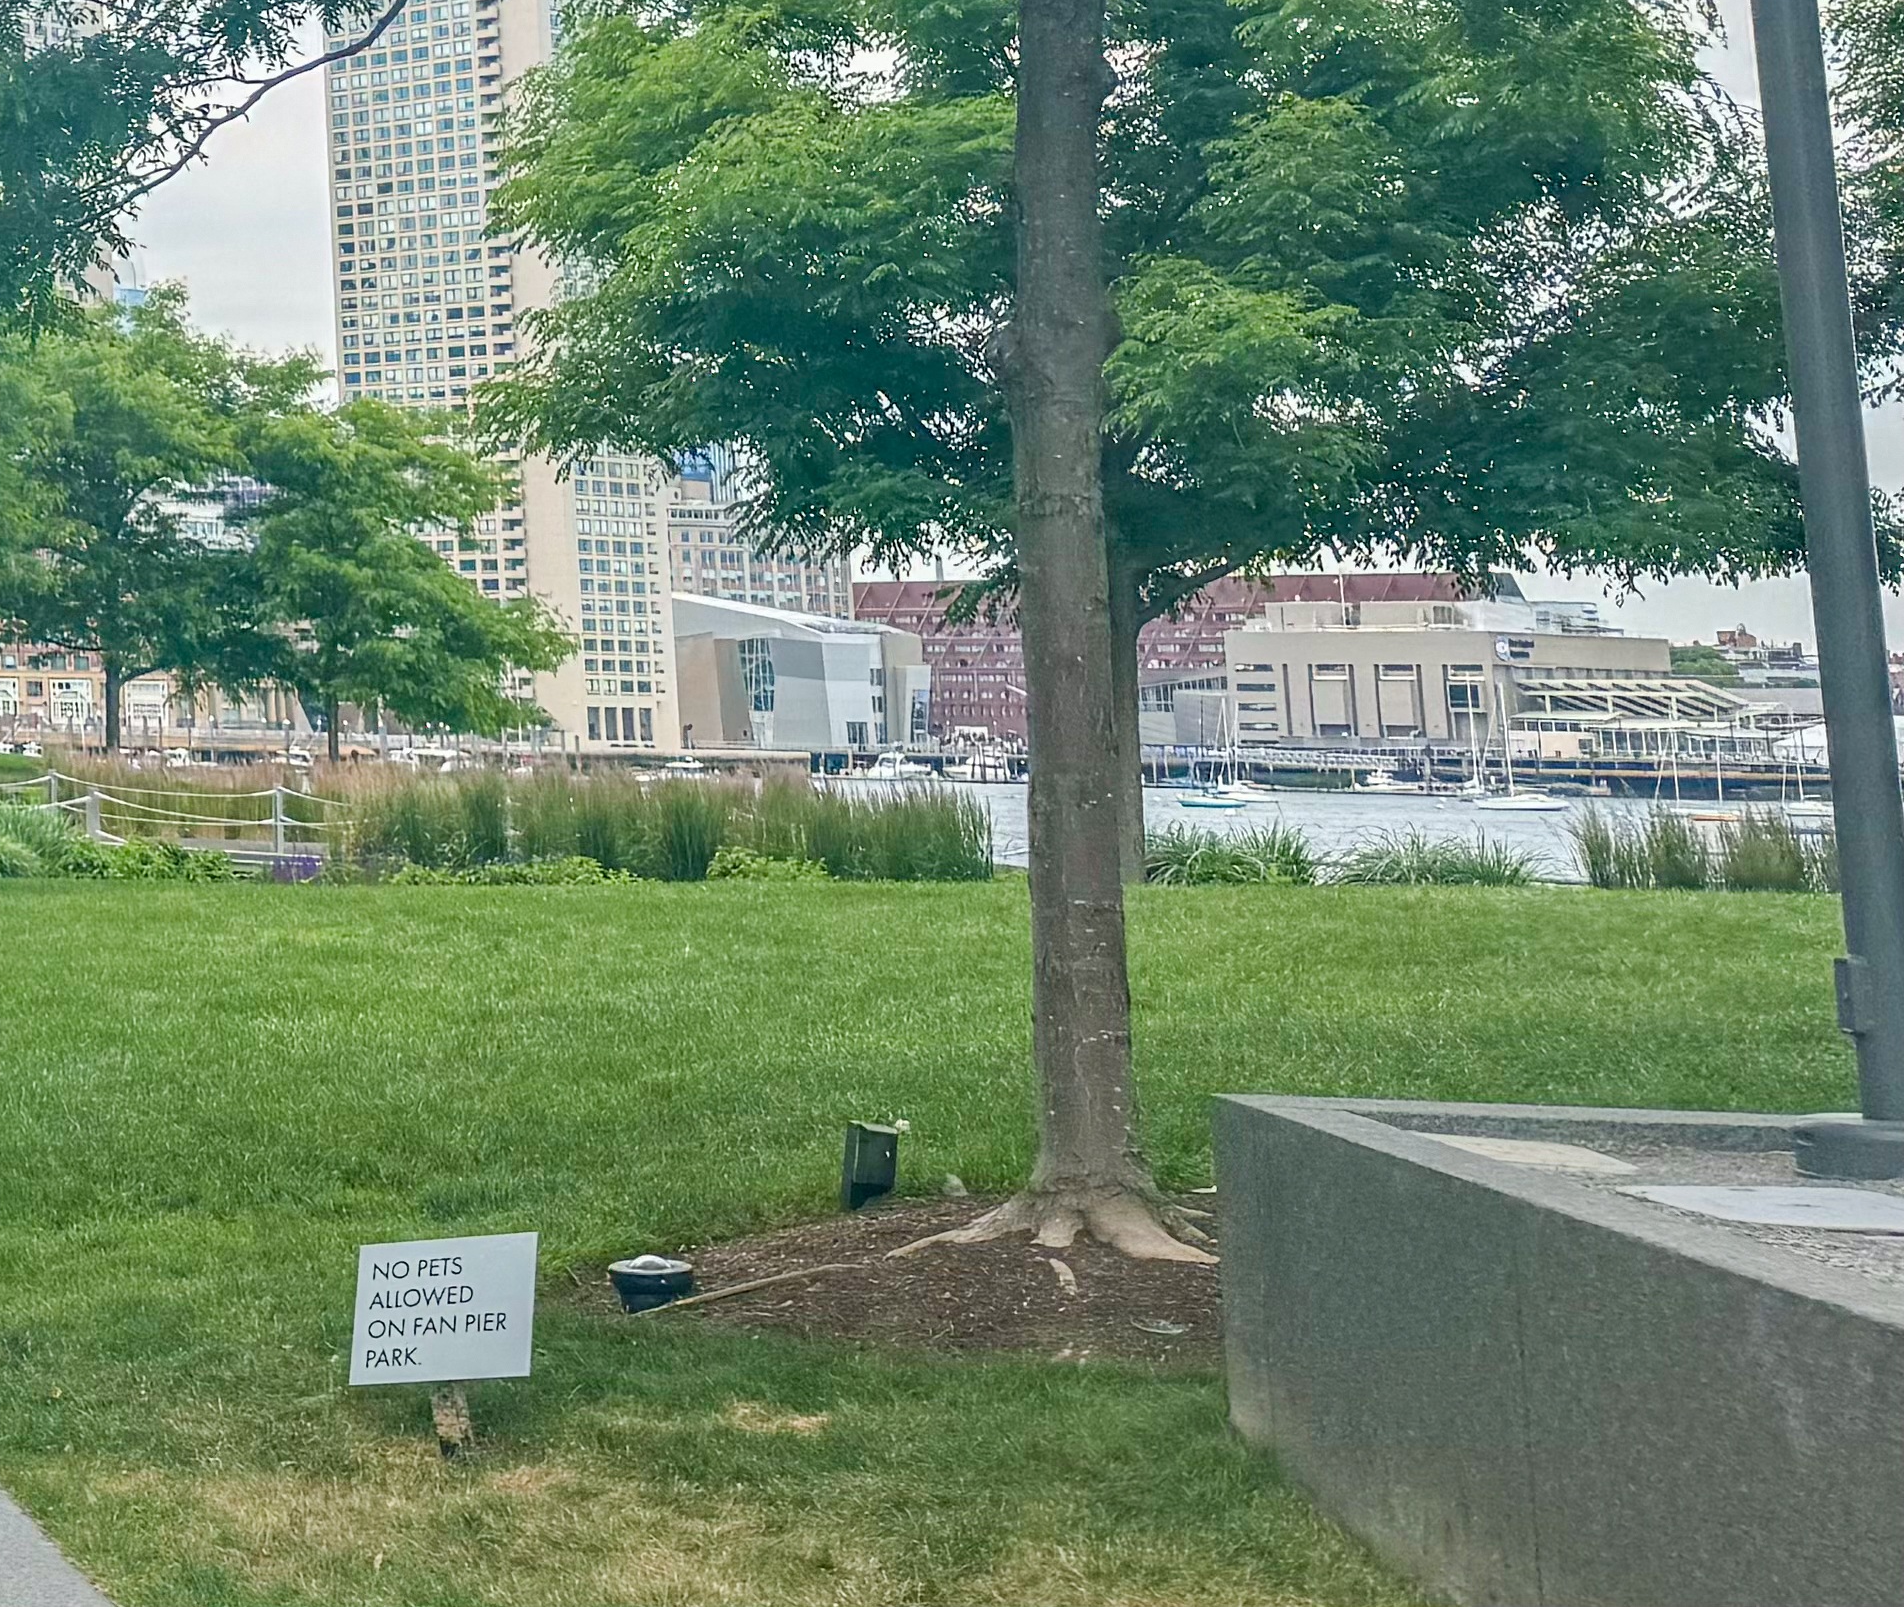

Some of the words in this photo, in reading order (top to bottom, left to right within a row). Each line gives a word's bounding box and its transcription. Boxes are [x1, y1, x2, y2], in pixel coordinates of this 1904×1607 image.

[372, 1260, 410, 1281] NO
[417, 1256, 463, 1278] PETS
[369, 1285, 474, 1310] ALLOWED
[368, 1318, 406, 1339] ON
[413, 1314, 457, 1336] FAN
[465, 1312, 507, 1333] PIER
[365, 1346, 422, 1369] PARK.
